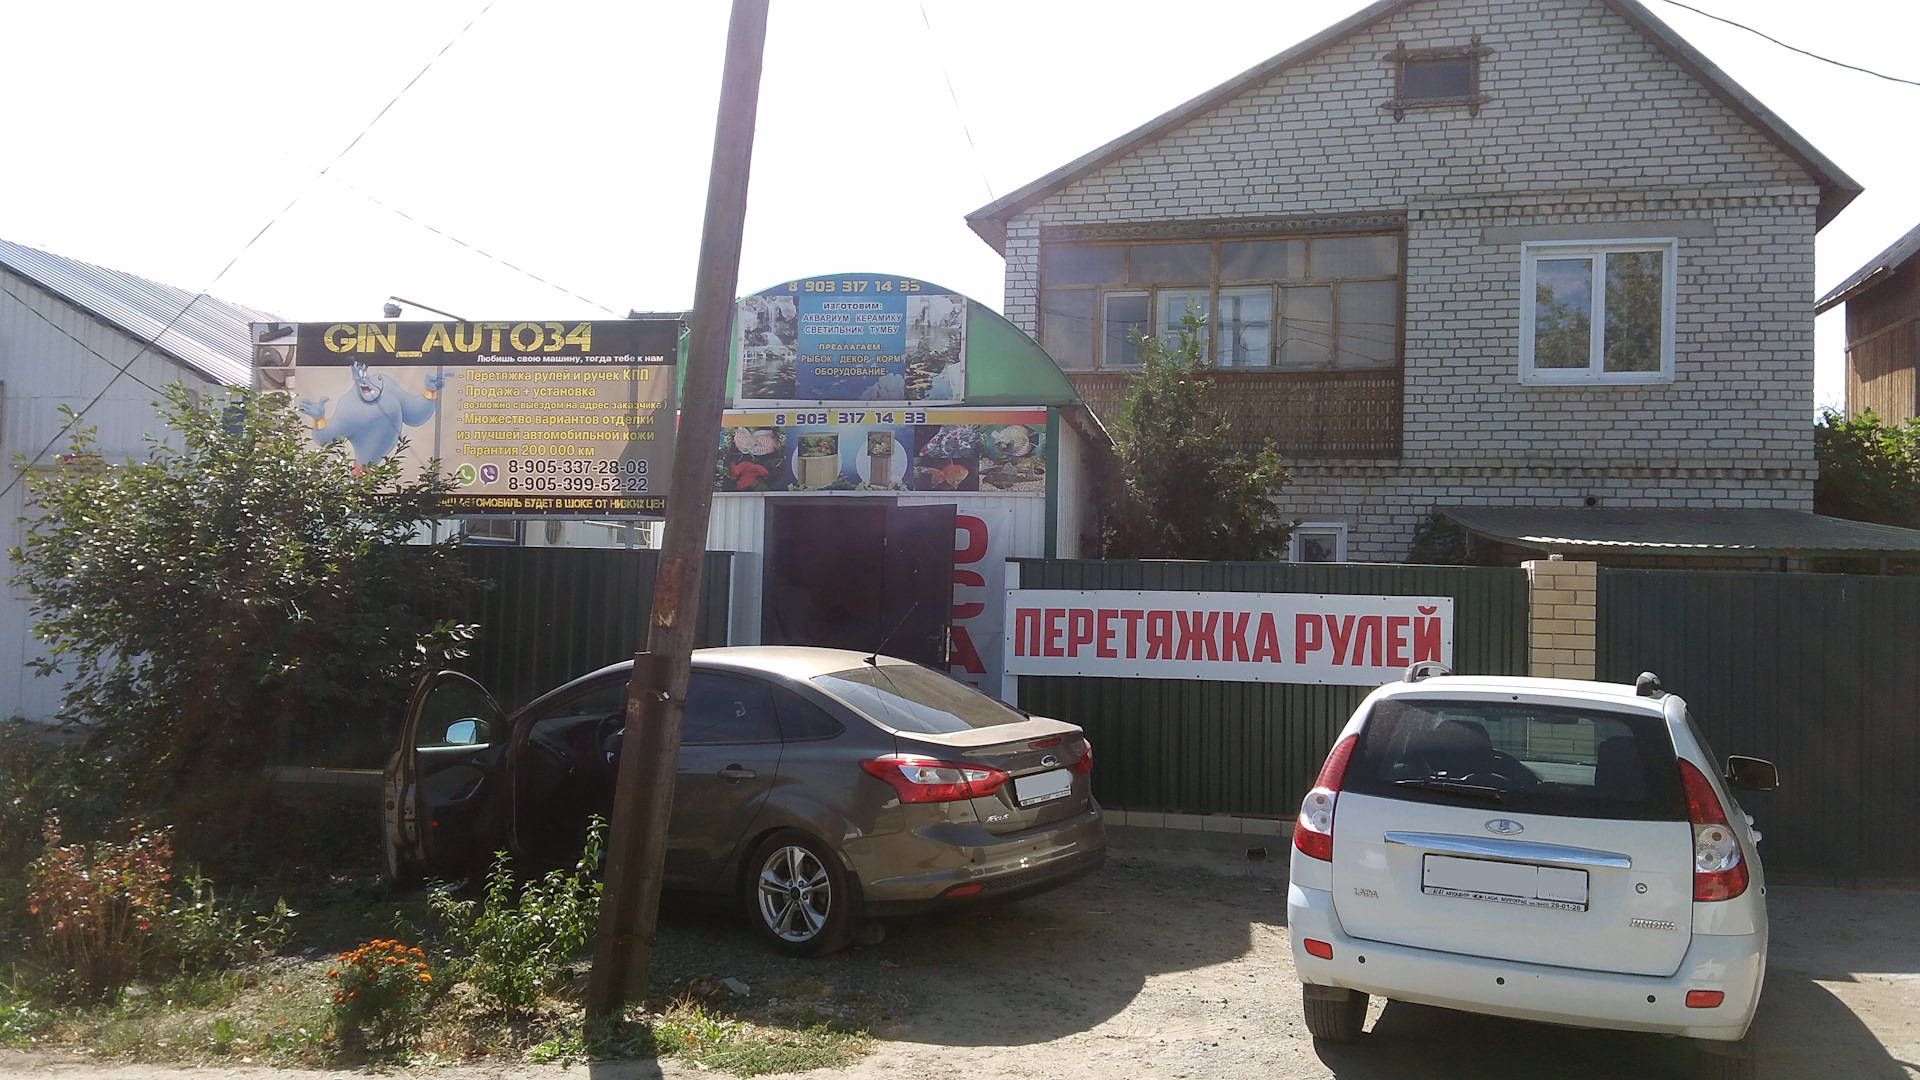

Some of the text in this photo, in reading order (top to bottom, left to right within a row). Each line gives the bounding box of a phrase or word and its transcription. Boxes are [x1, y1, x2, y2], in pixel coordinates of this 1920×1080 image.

[788, 281, 798, 292] 8
[805, 281, 835, 292] 903
[842, 281, 868, 292] 317
[875, 281, 892, 292] 14
[802, 314, 902, 322] АКВАРИУМ КЕРАМИКУ
[805, 326, 899, 334] СВЕТИЛЬНИК ТУМБУ
[323, 322, 592, 358] GIN_AUTO34
[819, 343, 884, 351] ПРЕДЛАГАЕМ:
[476, 355, 515, 363] Любишь
[517, 355, 541, 363] свою
[542, 355, 584, 364] машину,
[584, 355, 612, 364] тогда
[614, 354, 635, 362] тебе
[801, 355, 901, 364] РЫБОК ДЕКОР КОРМ
[466, 369, 531, 383] Перетяжка
[534, 369, 570, 383] рулей
[573, 372, 581, 381] и
[583, 372, 620, 383] ручек
[623, 369, 649, 381] КПП
[814, 368, 886, 376] ОБОРУДОВАНИЕ
[465, 385, 520, 398] Продажа
[533, 387, 596, 398] установка
[520, 402, 563, 411] выездом
[579, 402, 609, 410] адрес
[464, 412, 532, 424] Множество
[534, 415, 599, 427] вариантов
[602, 415, 654, 426] отделки
[775, 412, 927, 425] 8 903 317 14 33
[457, 428, 655, 442] из лучшей автомобильной кожи
[463, 443, 518, 458] Гарантия
[521, 444, 546, 456] 200
[549, 444, 575, 456] 000
[578, 446, 595, 456] км
[508, 459, 648, 474] 8-905-337-28-08
[508, 476, 648, 491] 8-905-399-52-22
[524, 498, 553, 510] БУДЕТ
[555, 499, 562, 508] В
[564, 499, 593, 508] ШОКЕ
[595, 499, 607, 508] ОТ
[610, 499, 644, 508] НИЗКИХ
[646, 499, 665, 510] ЦЕН
[1014, 606, 1441, 668] ПЕРЕТЯЖКА РУЛЕЙ
